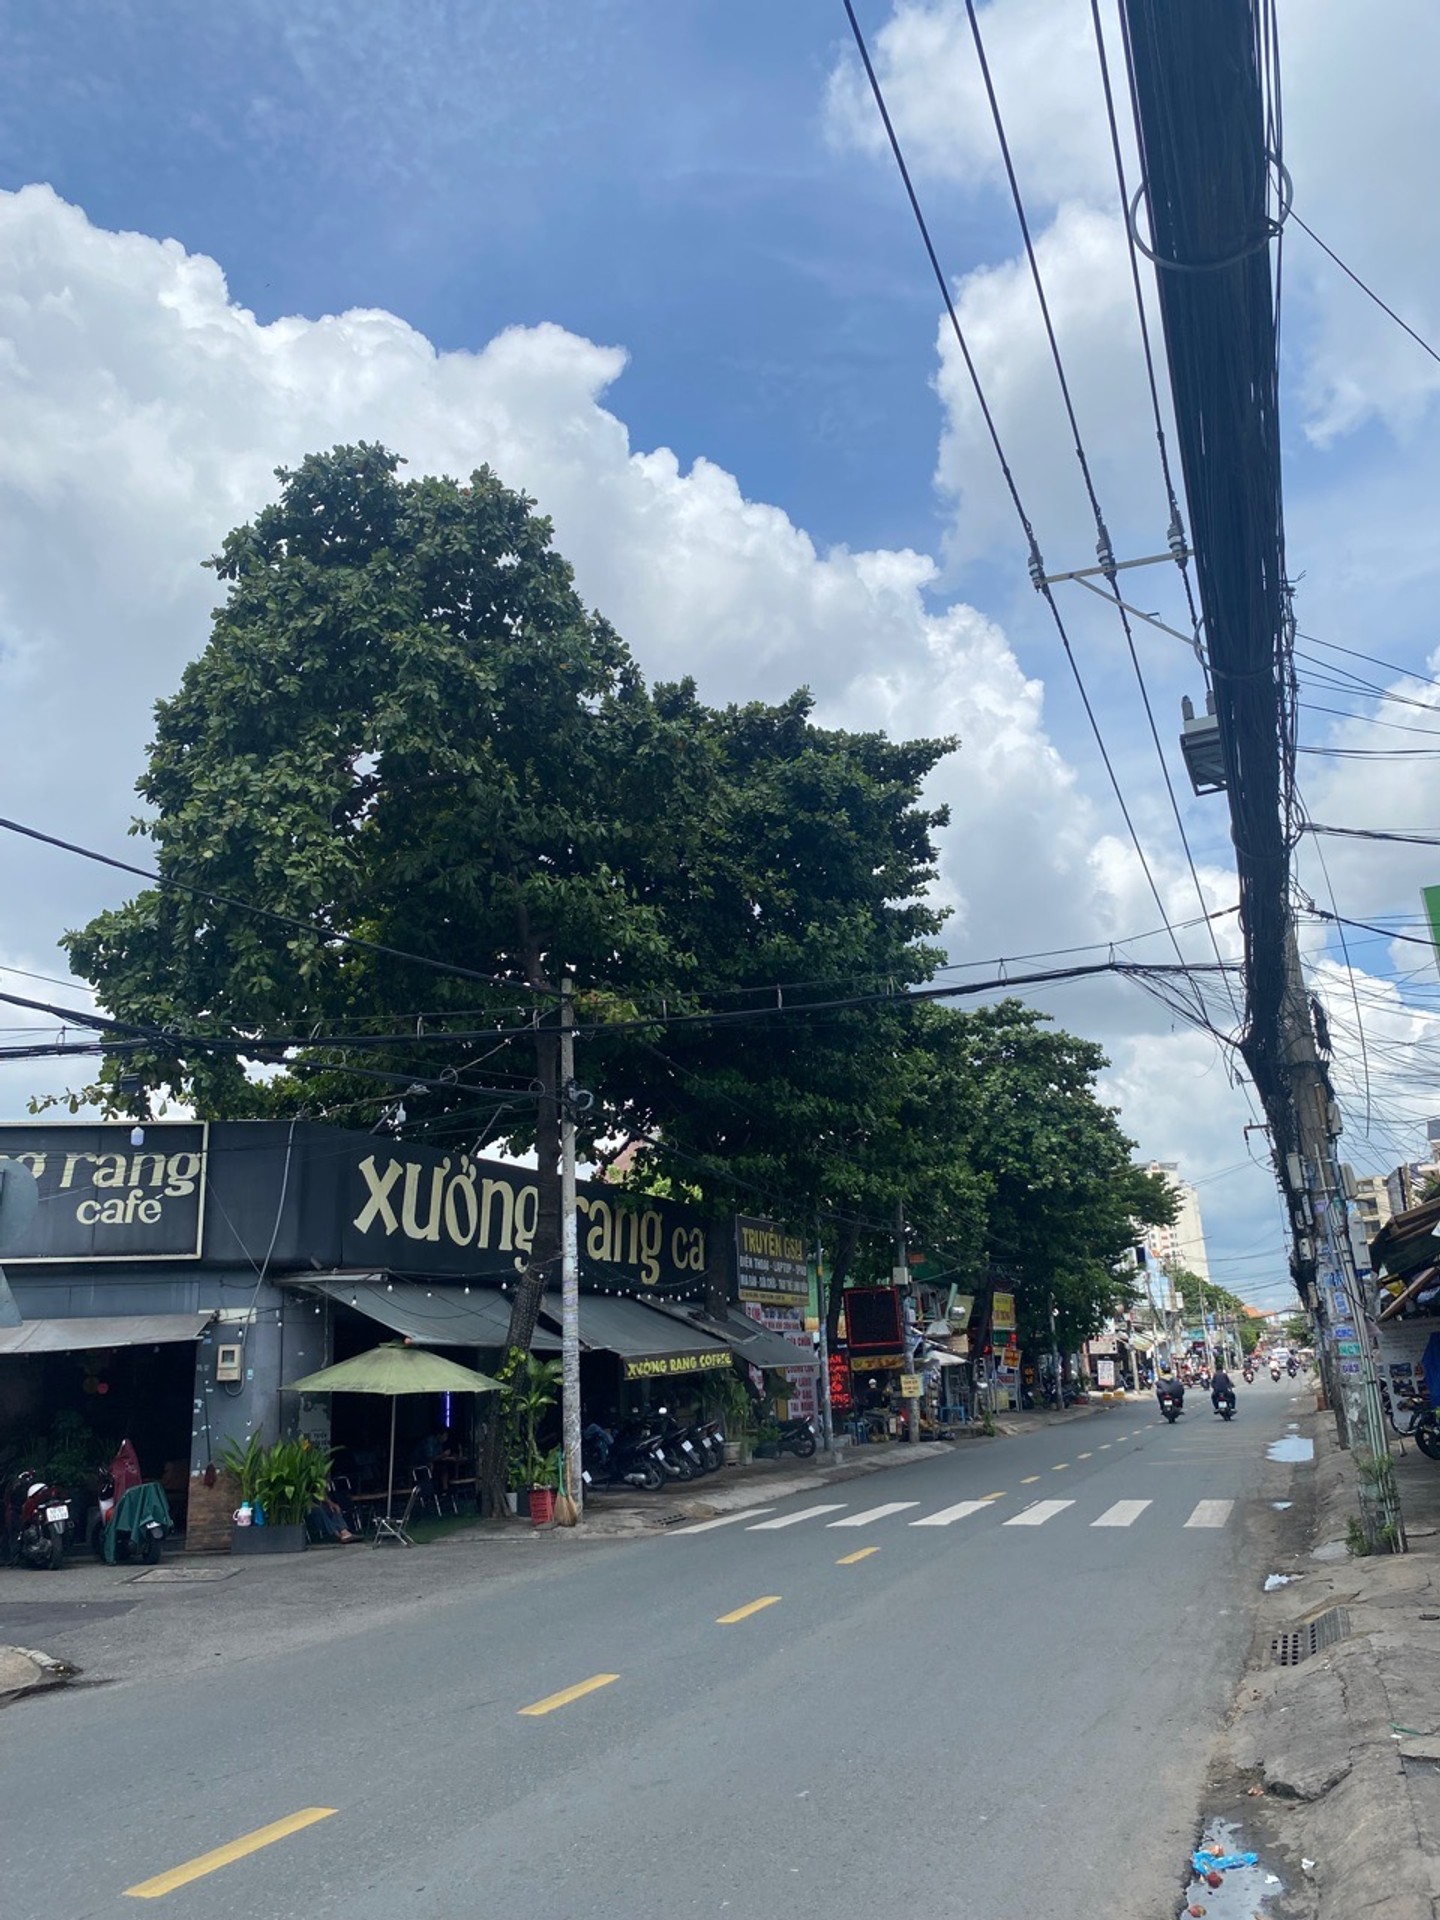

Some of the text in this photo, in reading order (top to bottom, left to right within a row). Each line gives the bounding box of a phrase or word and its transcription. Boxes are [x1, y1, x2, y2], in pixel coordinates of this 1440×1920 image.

[59, 1152, 203, 1197] rang
[76, 1188, 162, 1225] café
[669, 1356, 698, 1371] RANG
